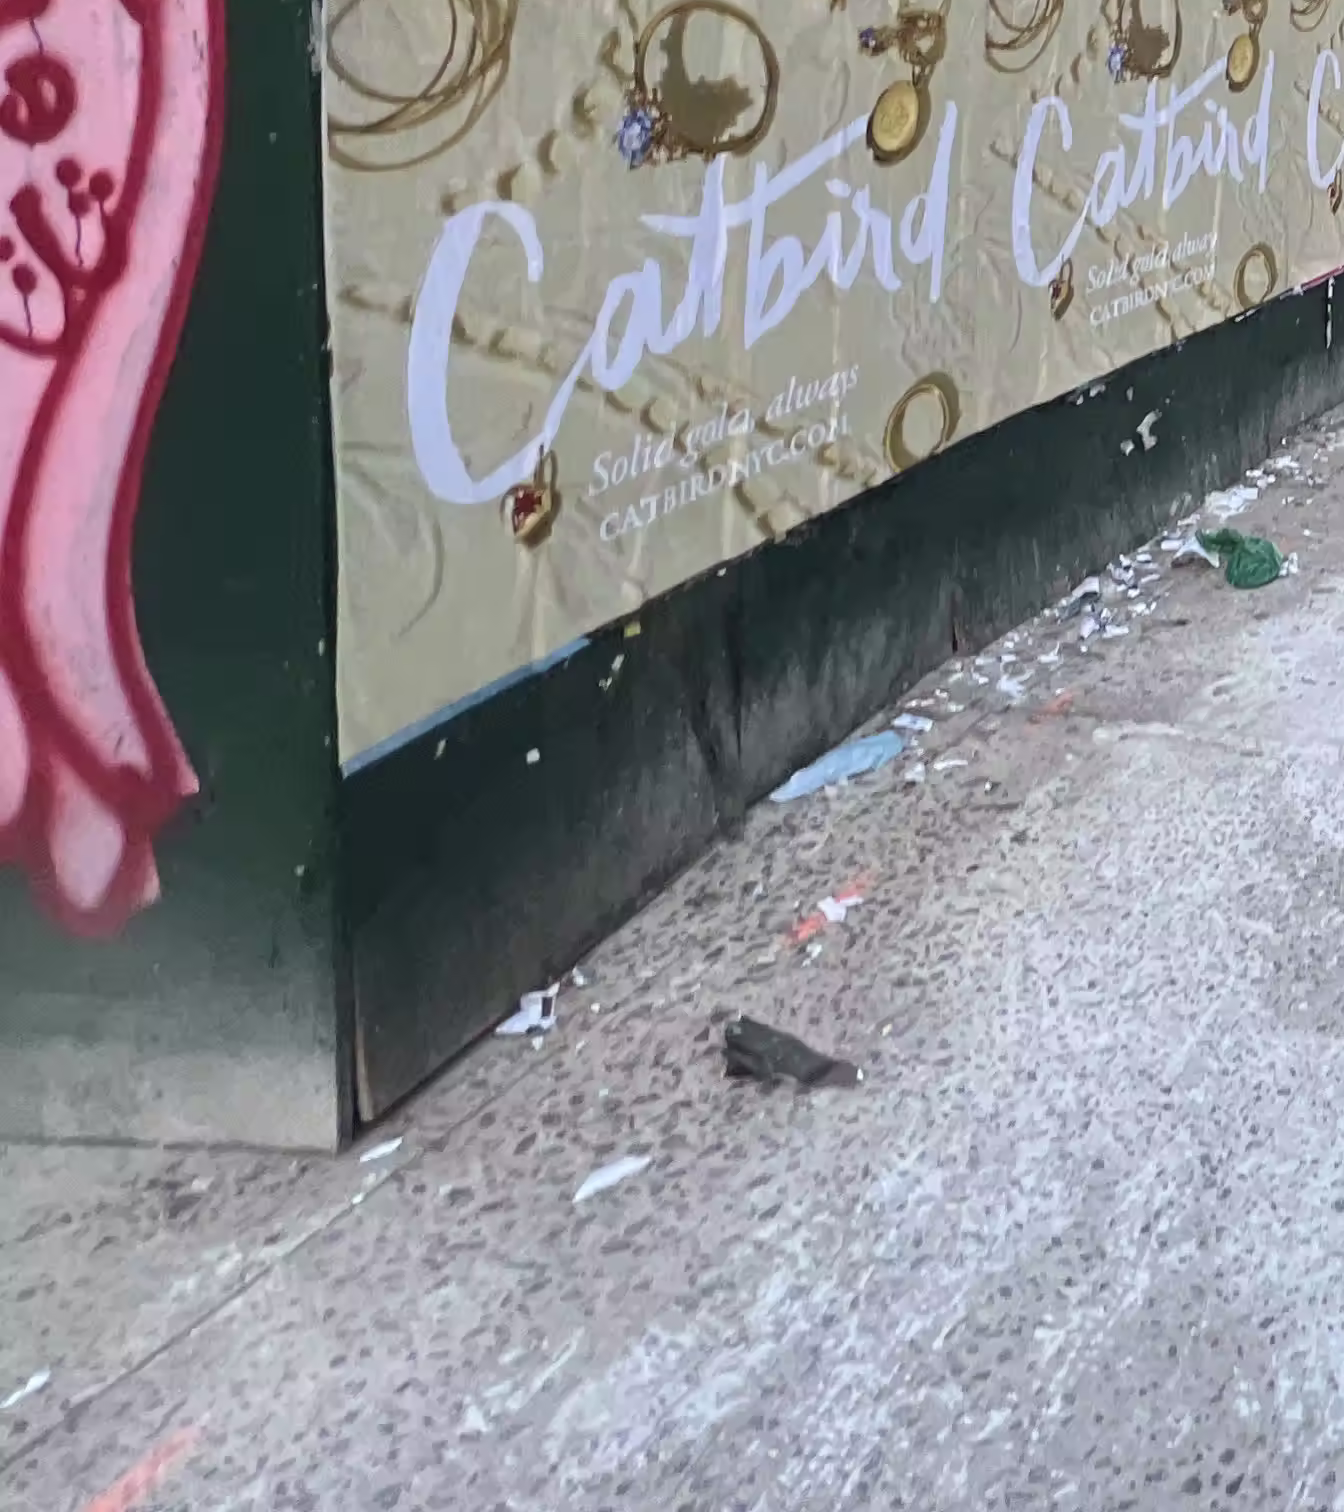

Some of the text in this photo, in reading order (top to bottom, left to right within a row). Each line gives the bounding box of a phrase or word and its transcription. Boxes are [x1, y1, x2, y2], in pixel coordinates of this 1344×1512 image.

[1012, 50, 1275, 286] Catbird
[407, 101, 957, 505] Catbird
[588, 419, 677, 497] Solid
[764, 364, 860, 423] always
